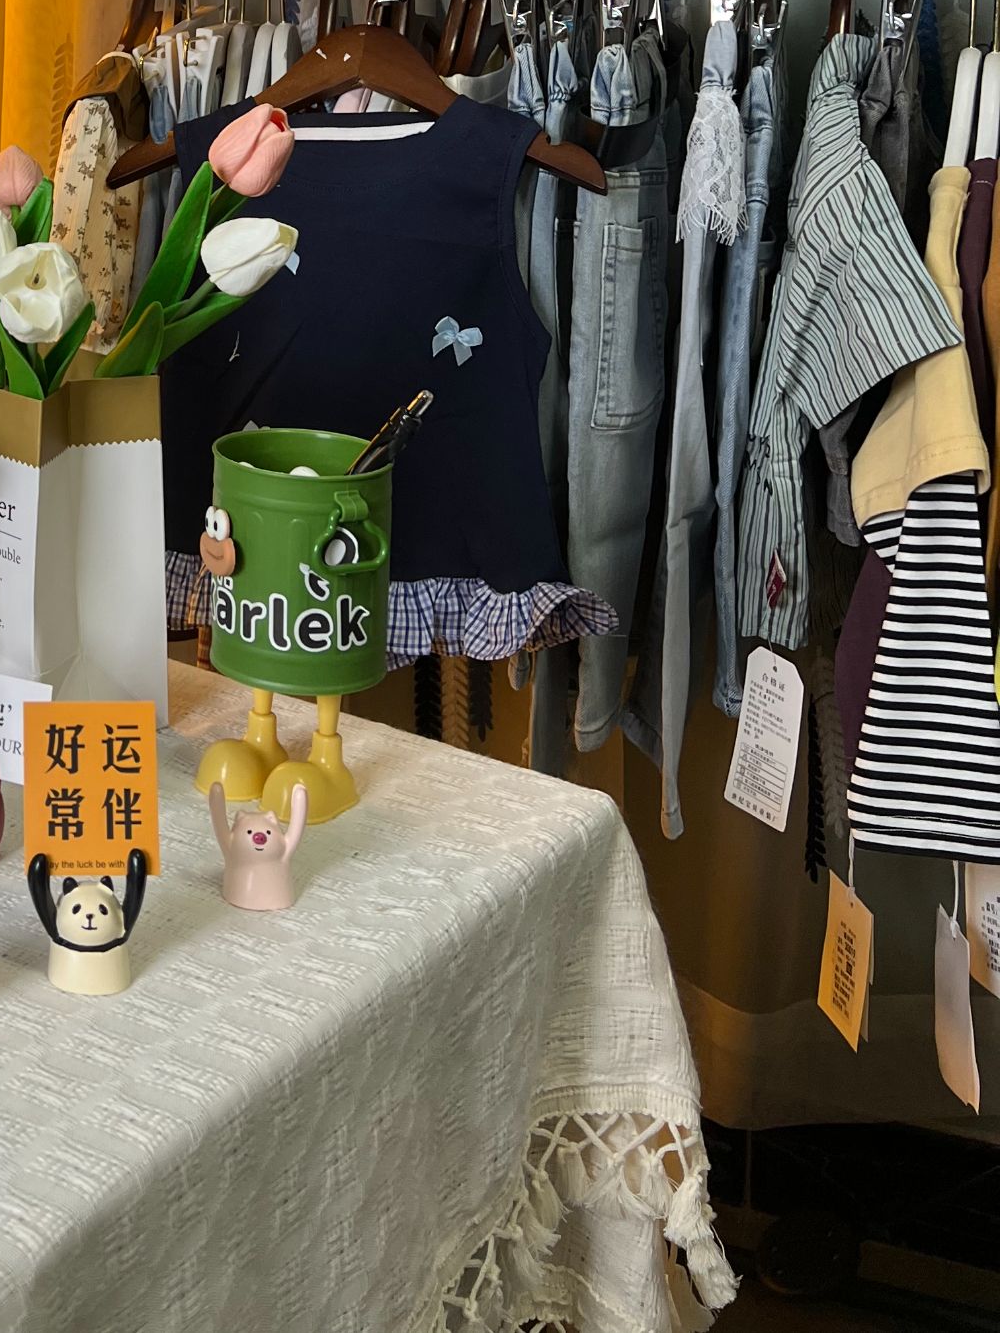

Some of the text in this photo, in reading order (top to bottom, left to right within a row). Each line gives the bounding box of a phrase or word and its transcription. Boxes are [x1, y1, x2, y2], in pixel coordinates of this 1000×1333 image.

[211, 576, 371, 653] ärlek
[761, 672, 786, 692] 合格证
[45, 723, 142, 774] 好运
[45, 788, 142, 840] 常伴
[61, 859, 74, 869] the
[76, 859, 93, 869] luck
[95, 859, 106, 869] be
[108, 859, 125, 869] with
